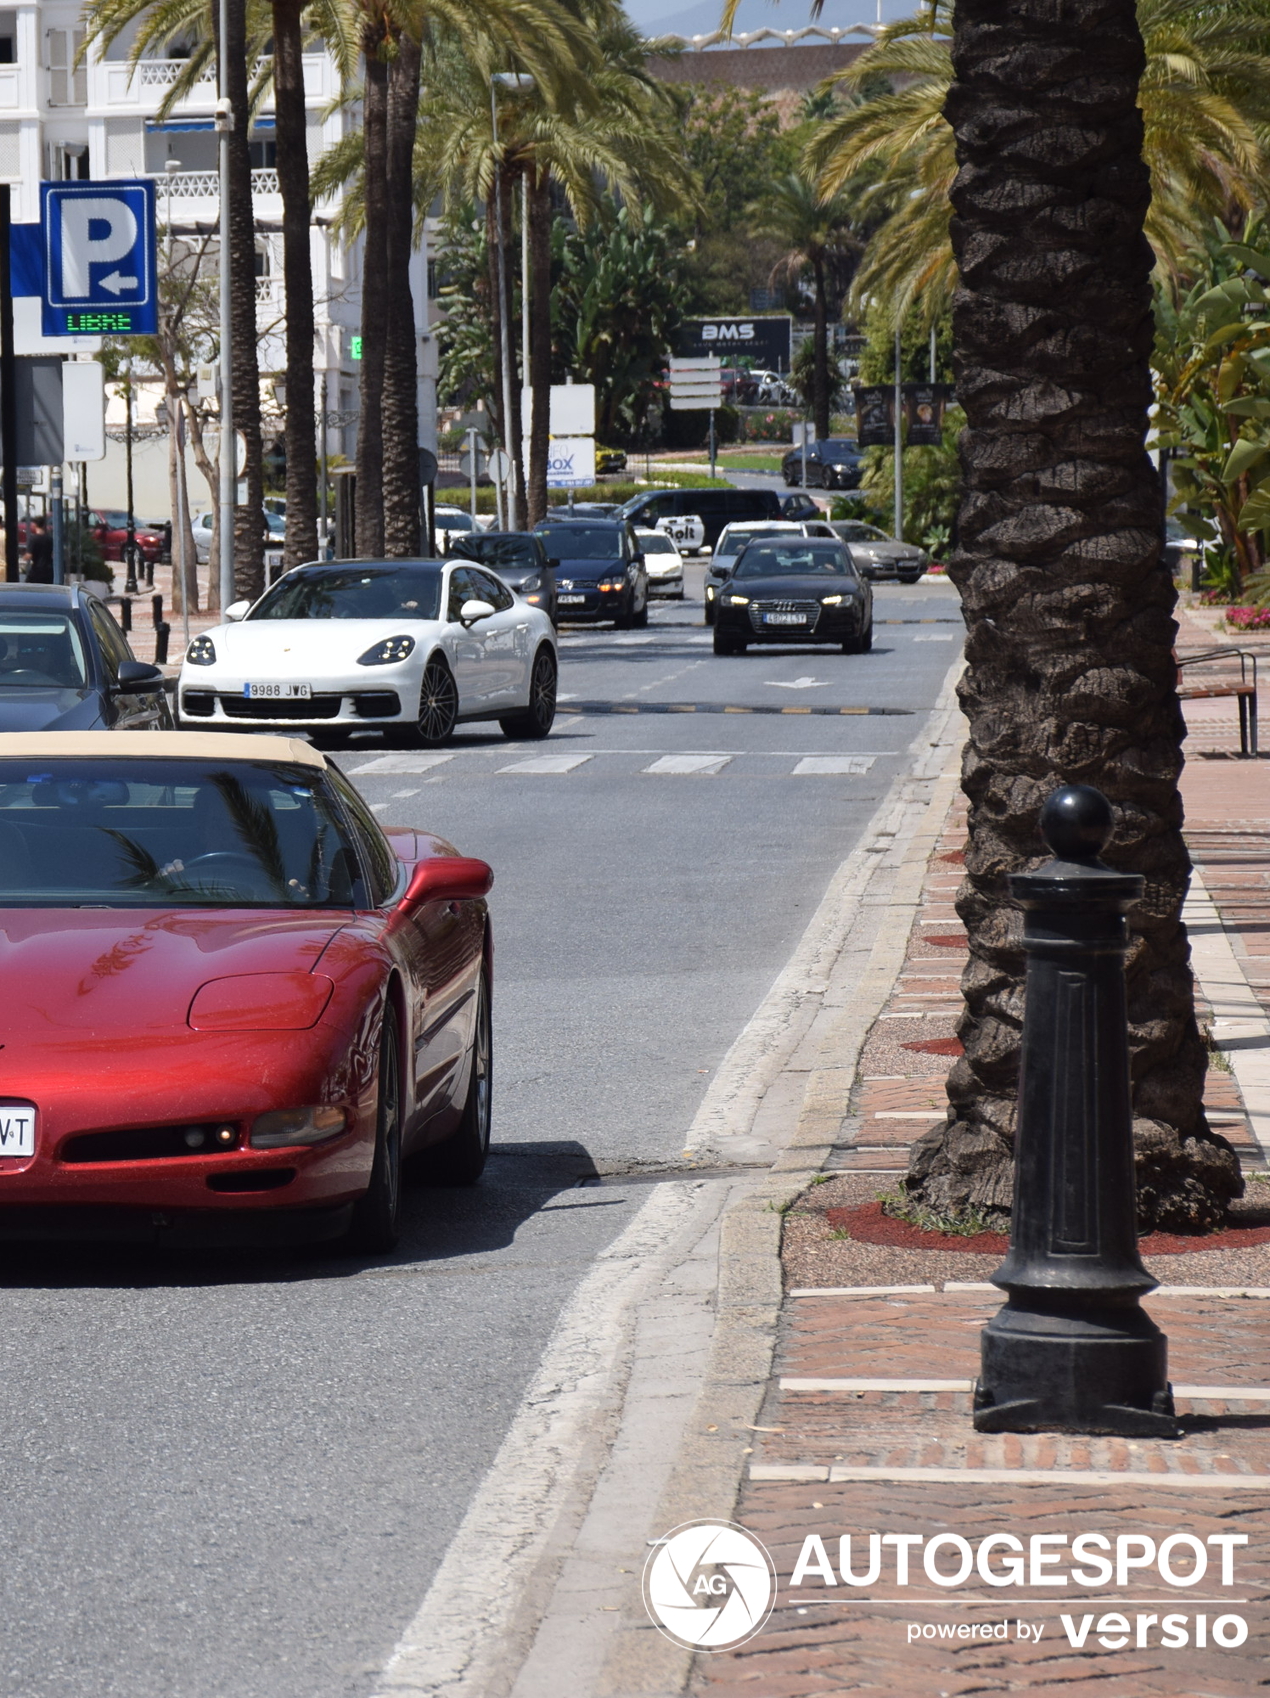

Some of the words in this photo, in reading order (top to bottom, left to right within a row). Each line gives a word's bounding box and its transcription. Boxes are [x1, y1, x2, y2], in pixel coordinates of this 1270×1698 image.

[61, 198, 138, 298] P
[67, 314, 131, 331] LIBRE
[702, 323, 755, 340] BMS
[251, 685, 281, 696] 9988
